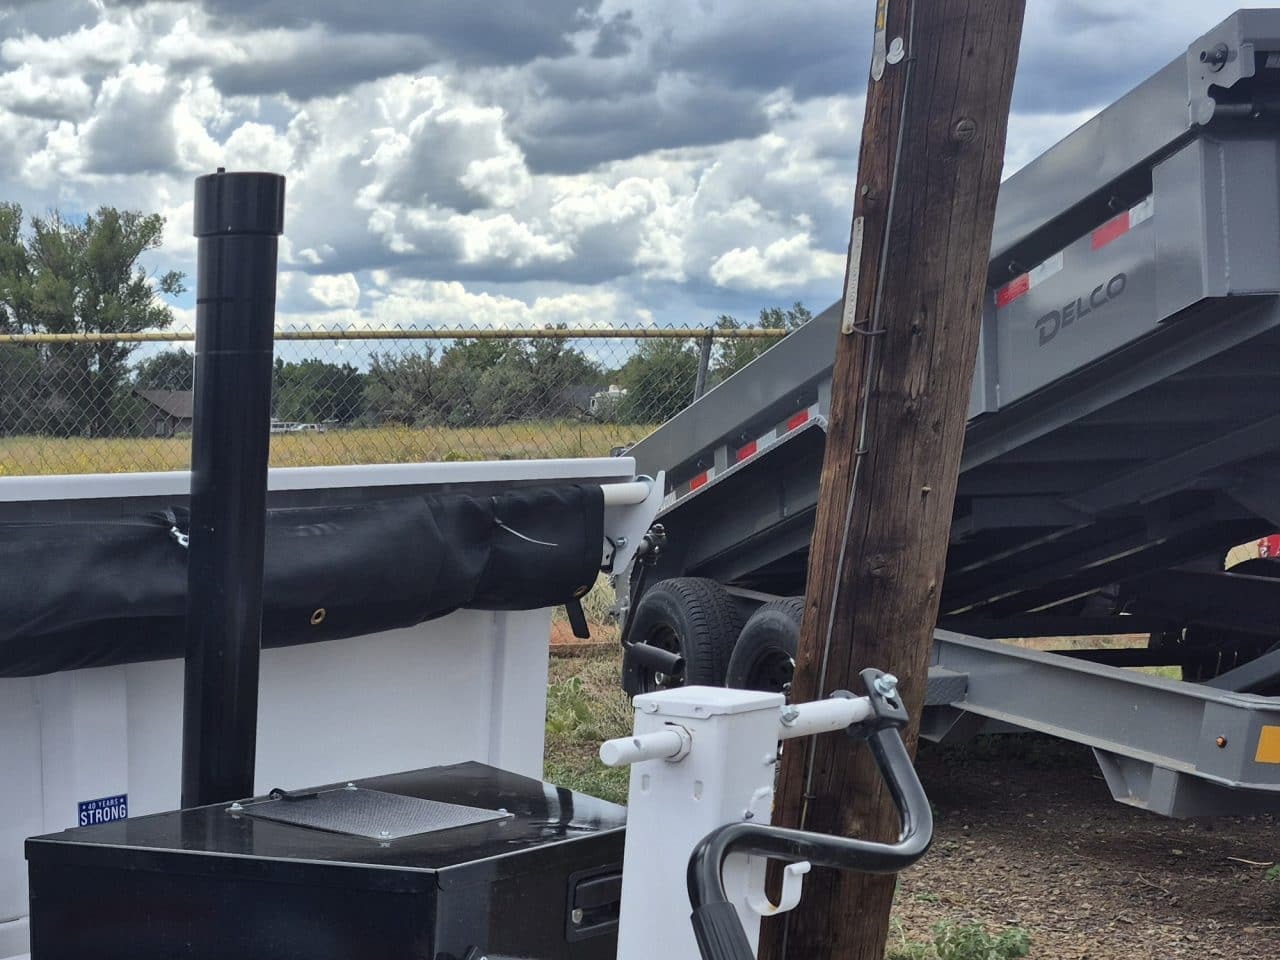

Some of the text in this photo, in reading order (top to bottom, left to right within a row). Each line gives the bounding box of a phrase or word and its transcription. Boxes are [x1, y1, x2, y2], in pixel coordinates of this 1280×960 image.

[1034, 272, 1127, 347] DELCO
[99, 798, 119, 808] YEARS
[80, 804, 127, 826] STRONG
